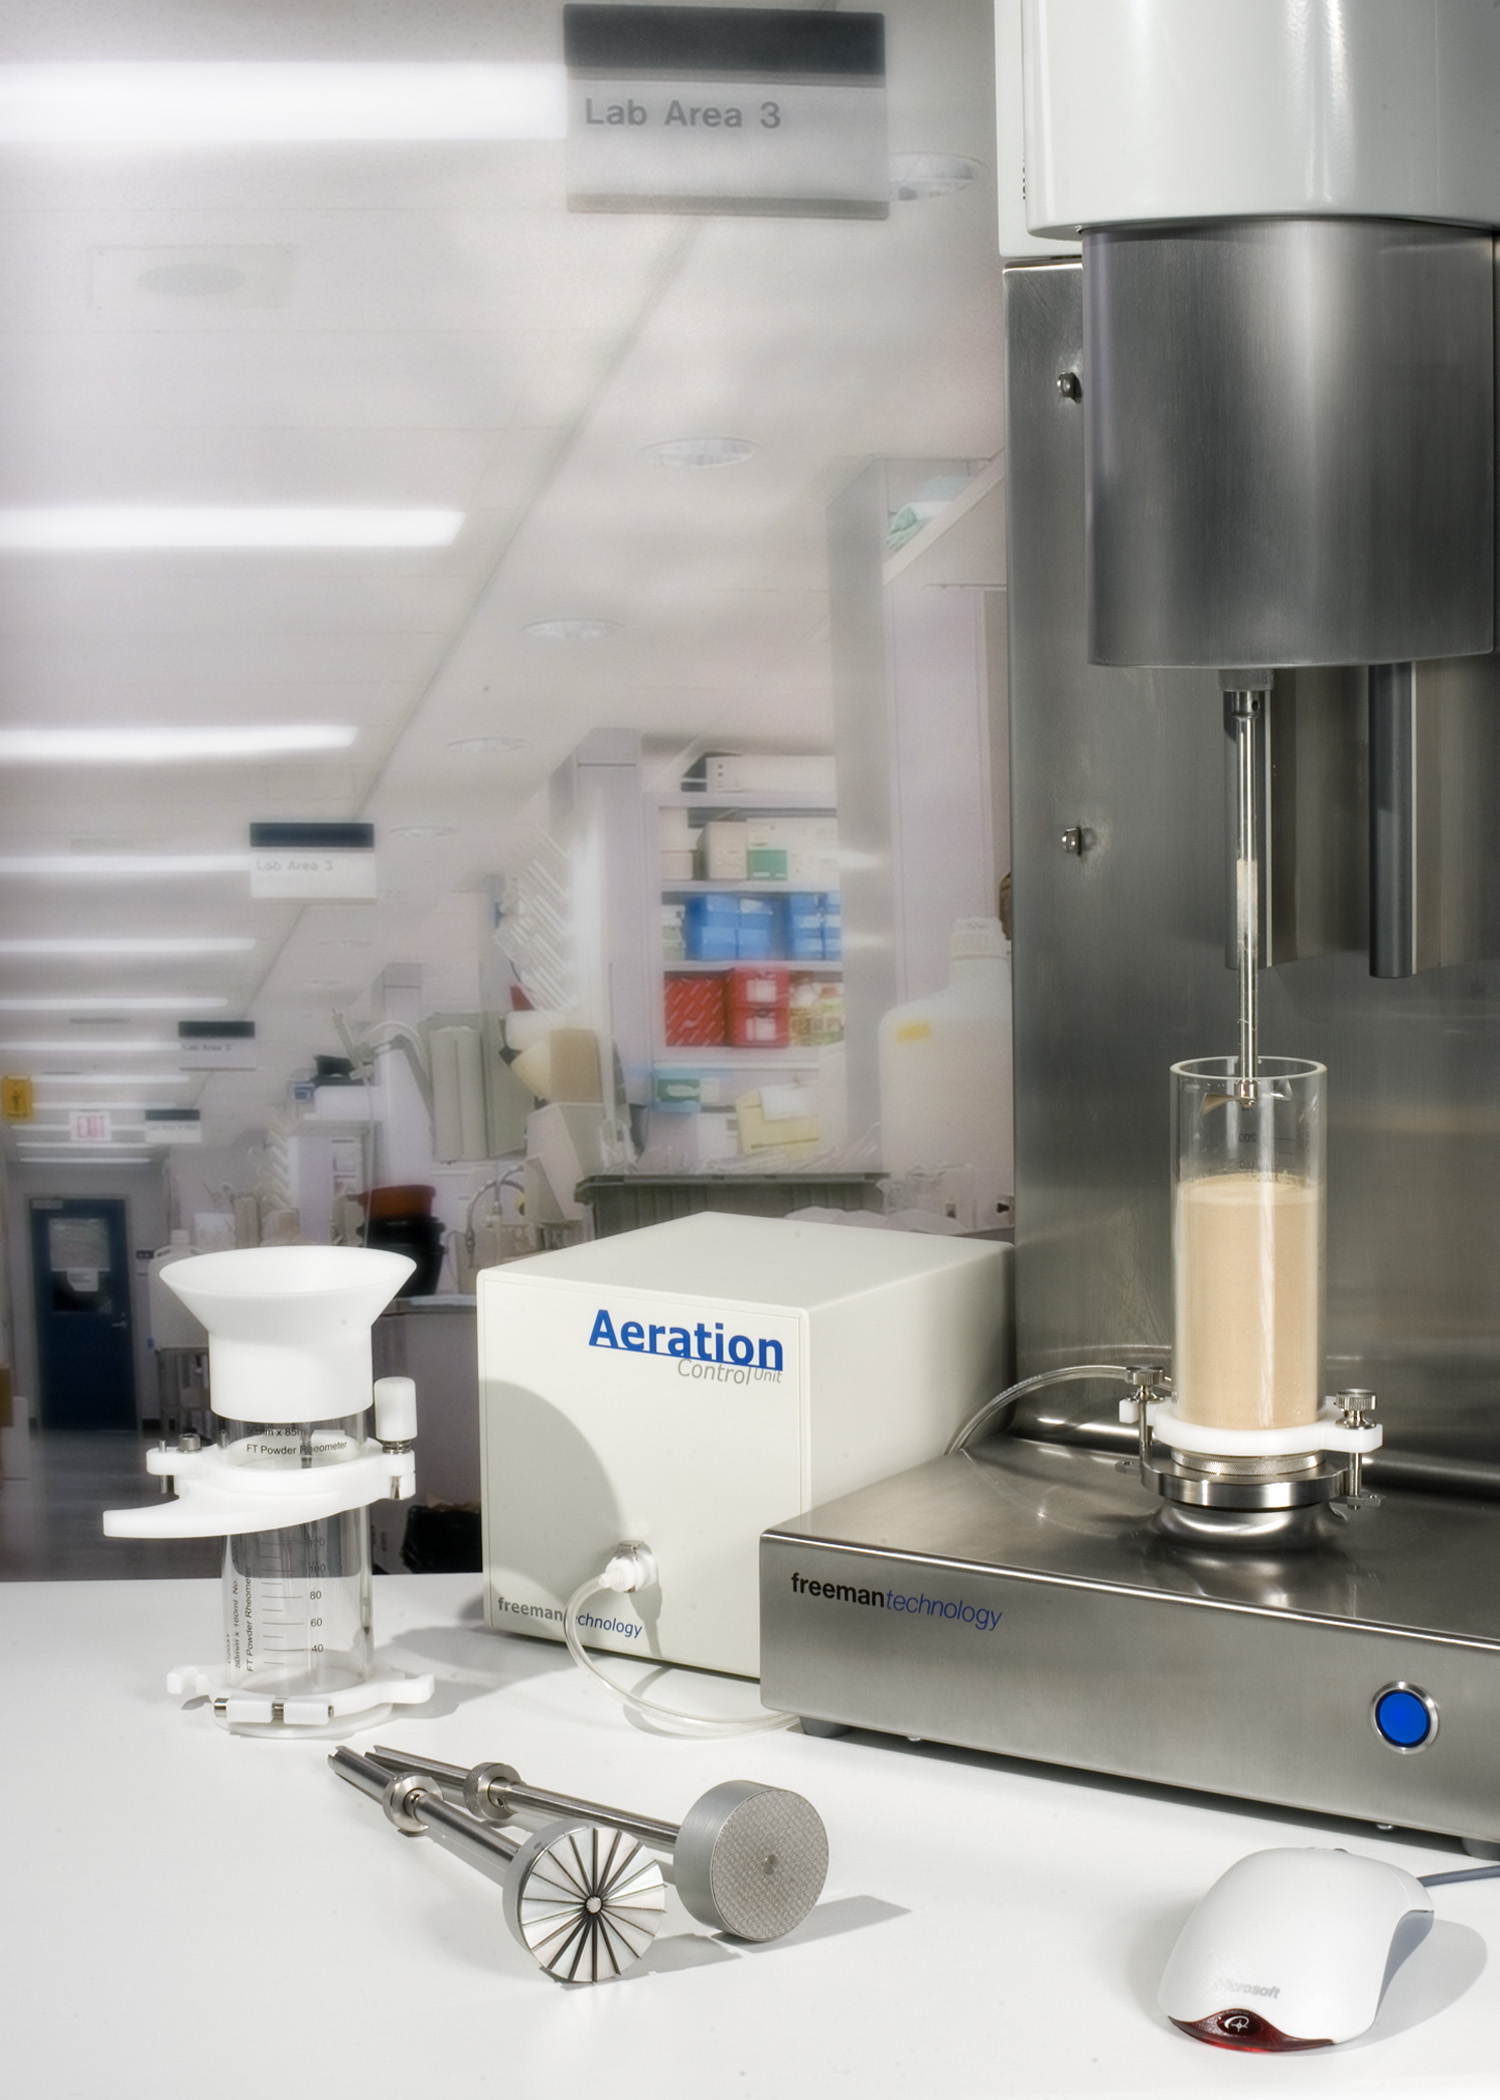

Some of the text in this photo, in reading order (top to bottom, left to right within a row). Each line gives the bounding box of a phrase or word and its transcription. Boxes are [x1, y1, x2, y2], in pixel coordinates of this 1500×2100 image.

[585, 98, 782, 129] Lab Area 3
[256, 860, 282, 871] Lab
[288, 860, 319, 871] Area
[588, 1309, 783, 1371] Aeration
[677, 1358, 782, 1385] Control Unit
[246, 1443, 258, 1453] FT
[260, 1445, 297, 1455] Powder
[309, 1590, 322, 1600] 80
[244, 1566, 254, 1673] FT Powder Rheometer
[310, 1617, 323, 1627] 60
[311, 1644, 324, 1653] 40
